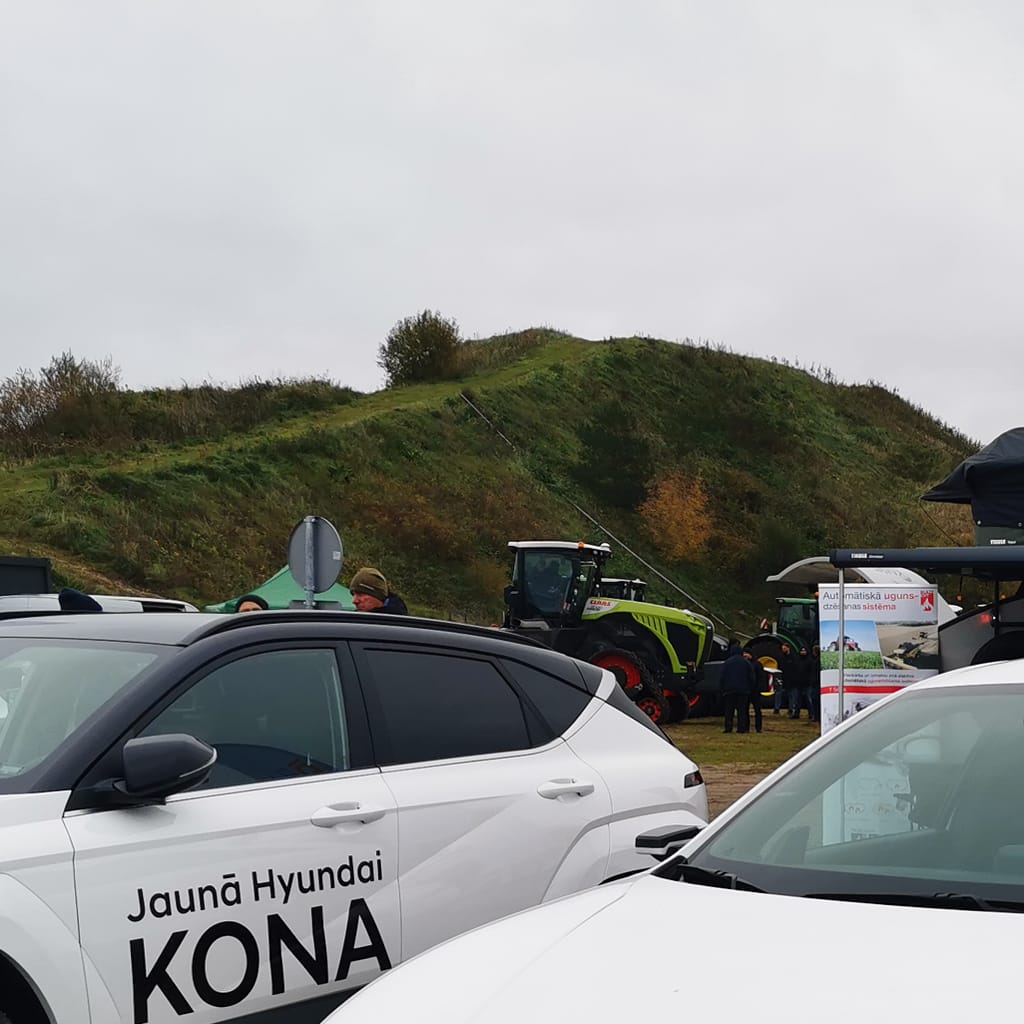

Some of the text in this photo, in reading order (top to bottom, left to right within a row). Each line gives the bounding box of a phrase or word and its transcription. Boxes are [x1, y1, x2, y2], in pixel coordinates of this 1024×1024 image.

[823, 590, 881, 600] Autmātiskā
[884, 593, 919, 602] uguns-
[863, 602, 896, 611] sistēma
[127, 850, 383, 922] Jaunā Hyundai
[129, 898, 392, 1024] KONA
